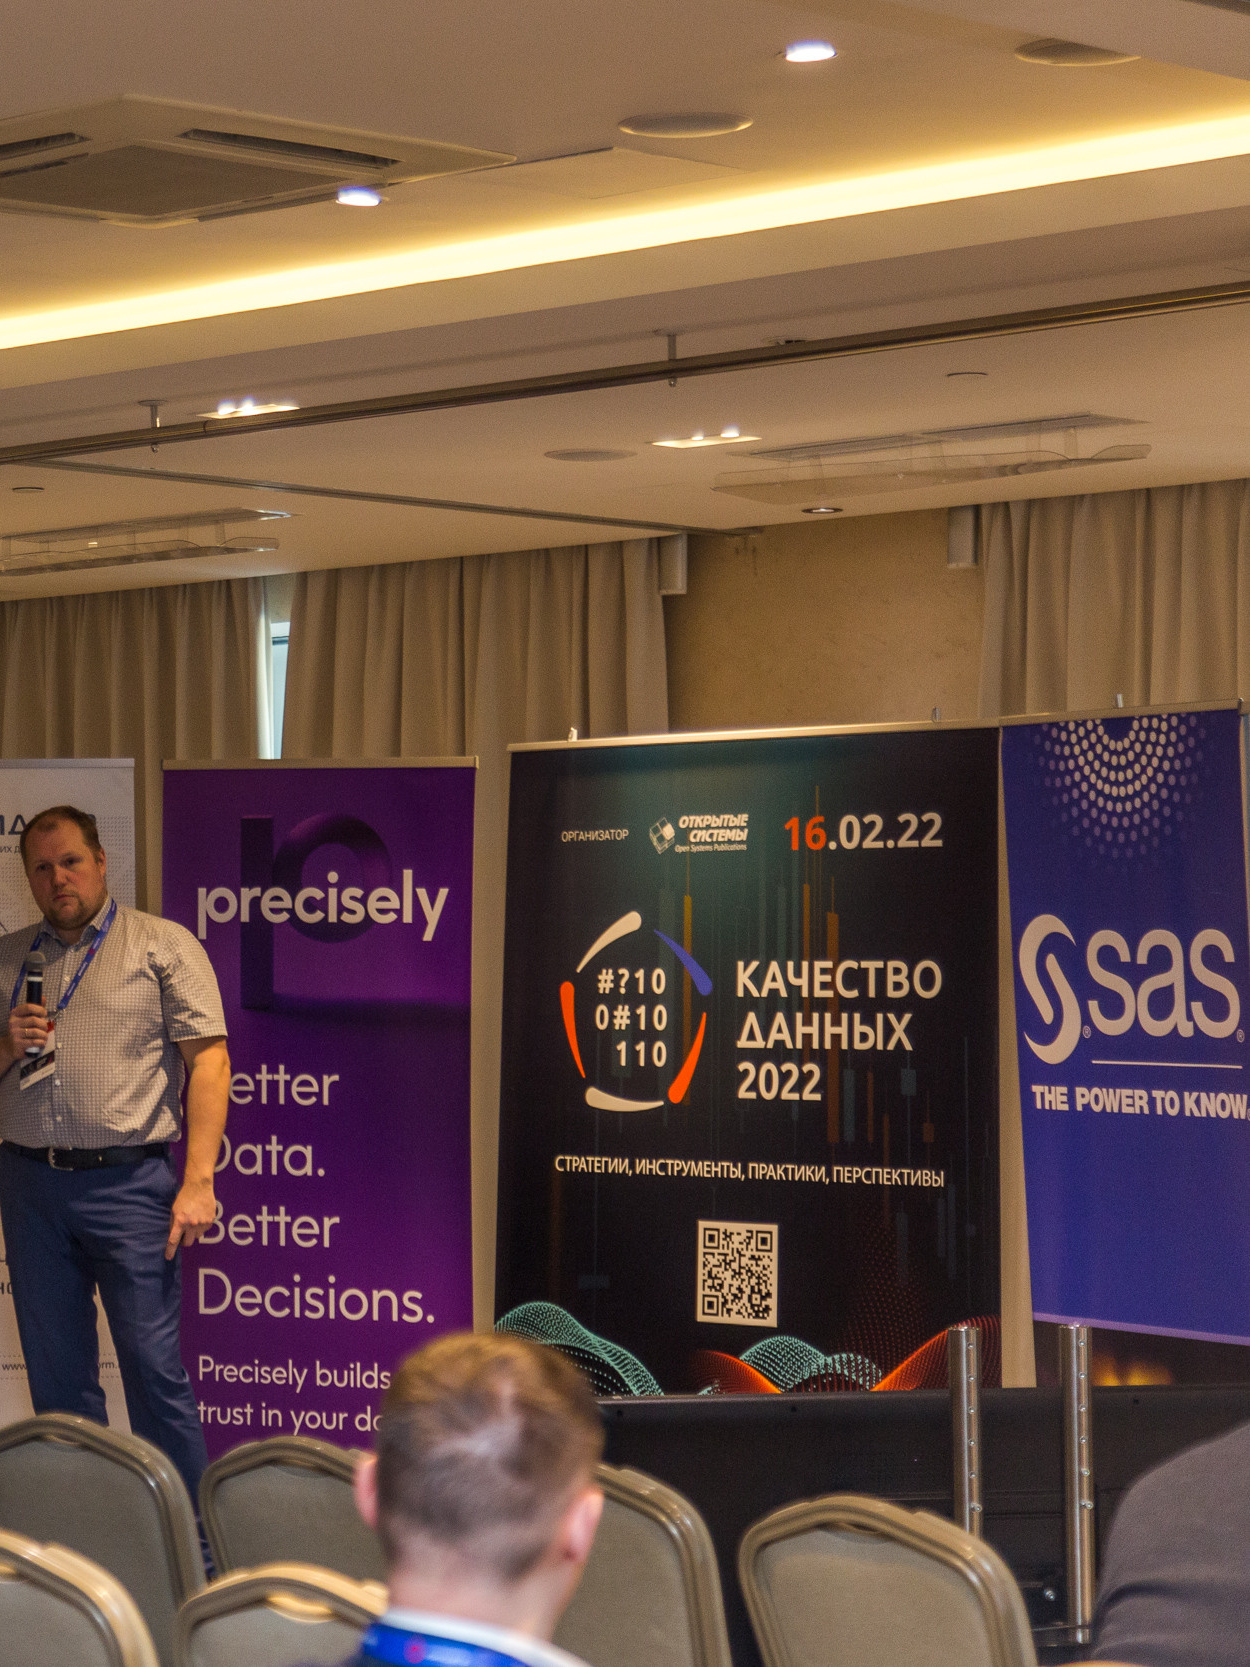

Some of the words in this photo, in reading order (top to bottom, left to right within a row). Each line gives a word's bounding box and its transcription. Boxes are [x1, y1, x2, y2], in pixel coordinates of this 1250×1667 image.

[560, 828, 630, 843] ОРГАНИЗАТОР
[678, 813, 749, 829] ОТКРЫТЫЕ
[688, 828, 749, 843] СИСТЕМЫ
[784, 812, 944, 852] 16.02.22
[674, 844, 689, 853] Open
[690, 844, 713, 853] Systems
[714, 843, 748, 851] Publications
[197, 868, 450, 942] precisely
[597, 967, 667, 995] #?10
[736, 960, 944, 999] КАЧЕСТВО
[1086, 928, 1241, 1040] sas
[736, 1011, 914, 1051] ДАННЫХ
[616, 1040, 668, 1068] 110
[228, 1063, 340, 1107] etter
[736, 1062, 823, 1101] 2022
[1031, 1084, 1069, 1112] THE
[1075, 1085, 1150, 1115] POWER
[1152, 1089, 1181, 1117] TO
[554, 1154, 633, 1177] СТРАТЕГИИ,
[635, 1158, 745, 1182] ИНСТРУМЕНТЫ,
[748, 1162, 830, 1185] ПРАКТИКИ,
[832, 1166, 945, 1188] ПЕРСПЕКТИВЫ
[198, 1199, 341, 1249] Better
[197, 1267, 436, 1324] Decisions.
[198, 1355, 308, 1394] Precisely
[315, 1360, 391, 1390] builds
[197, 1400, 254, 1426] trust
[260, 1401, 283, 1427] in
[289, 1409, 349, 1437] your
